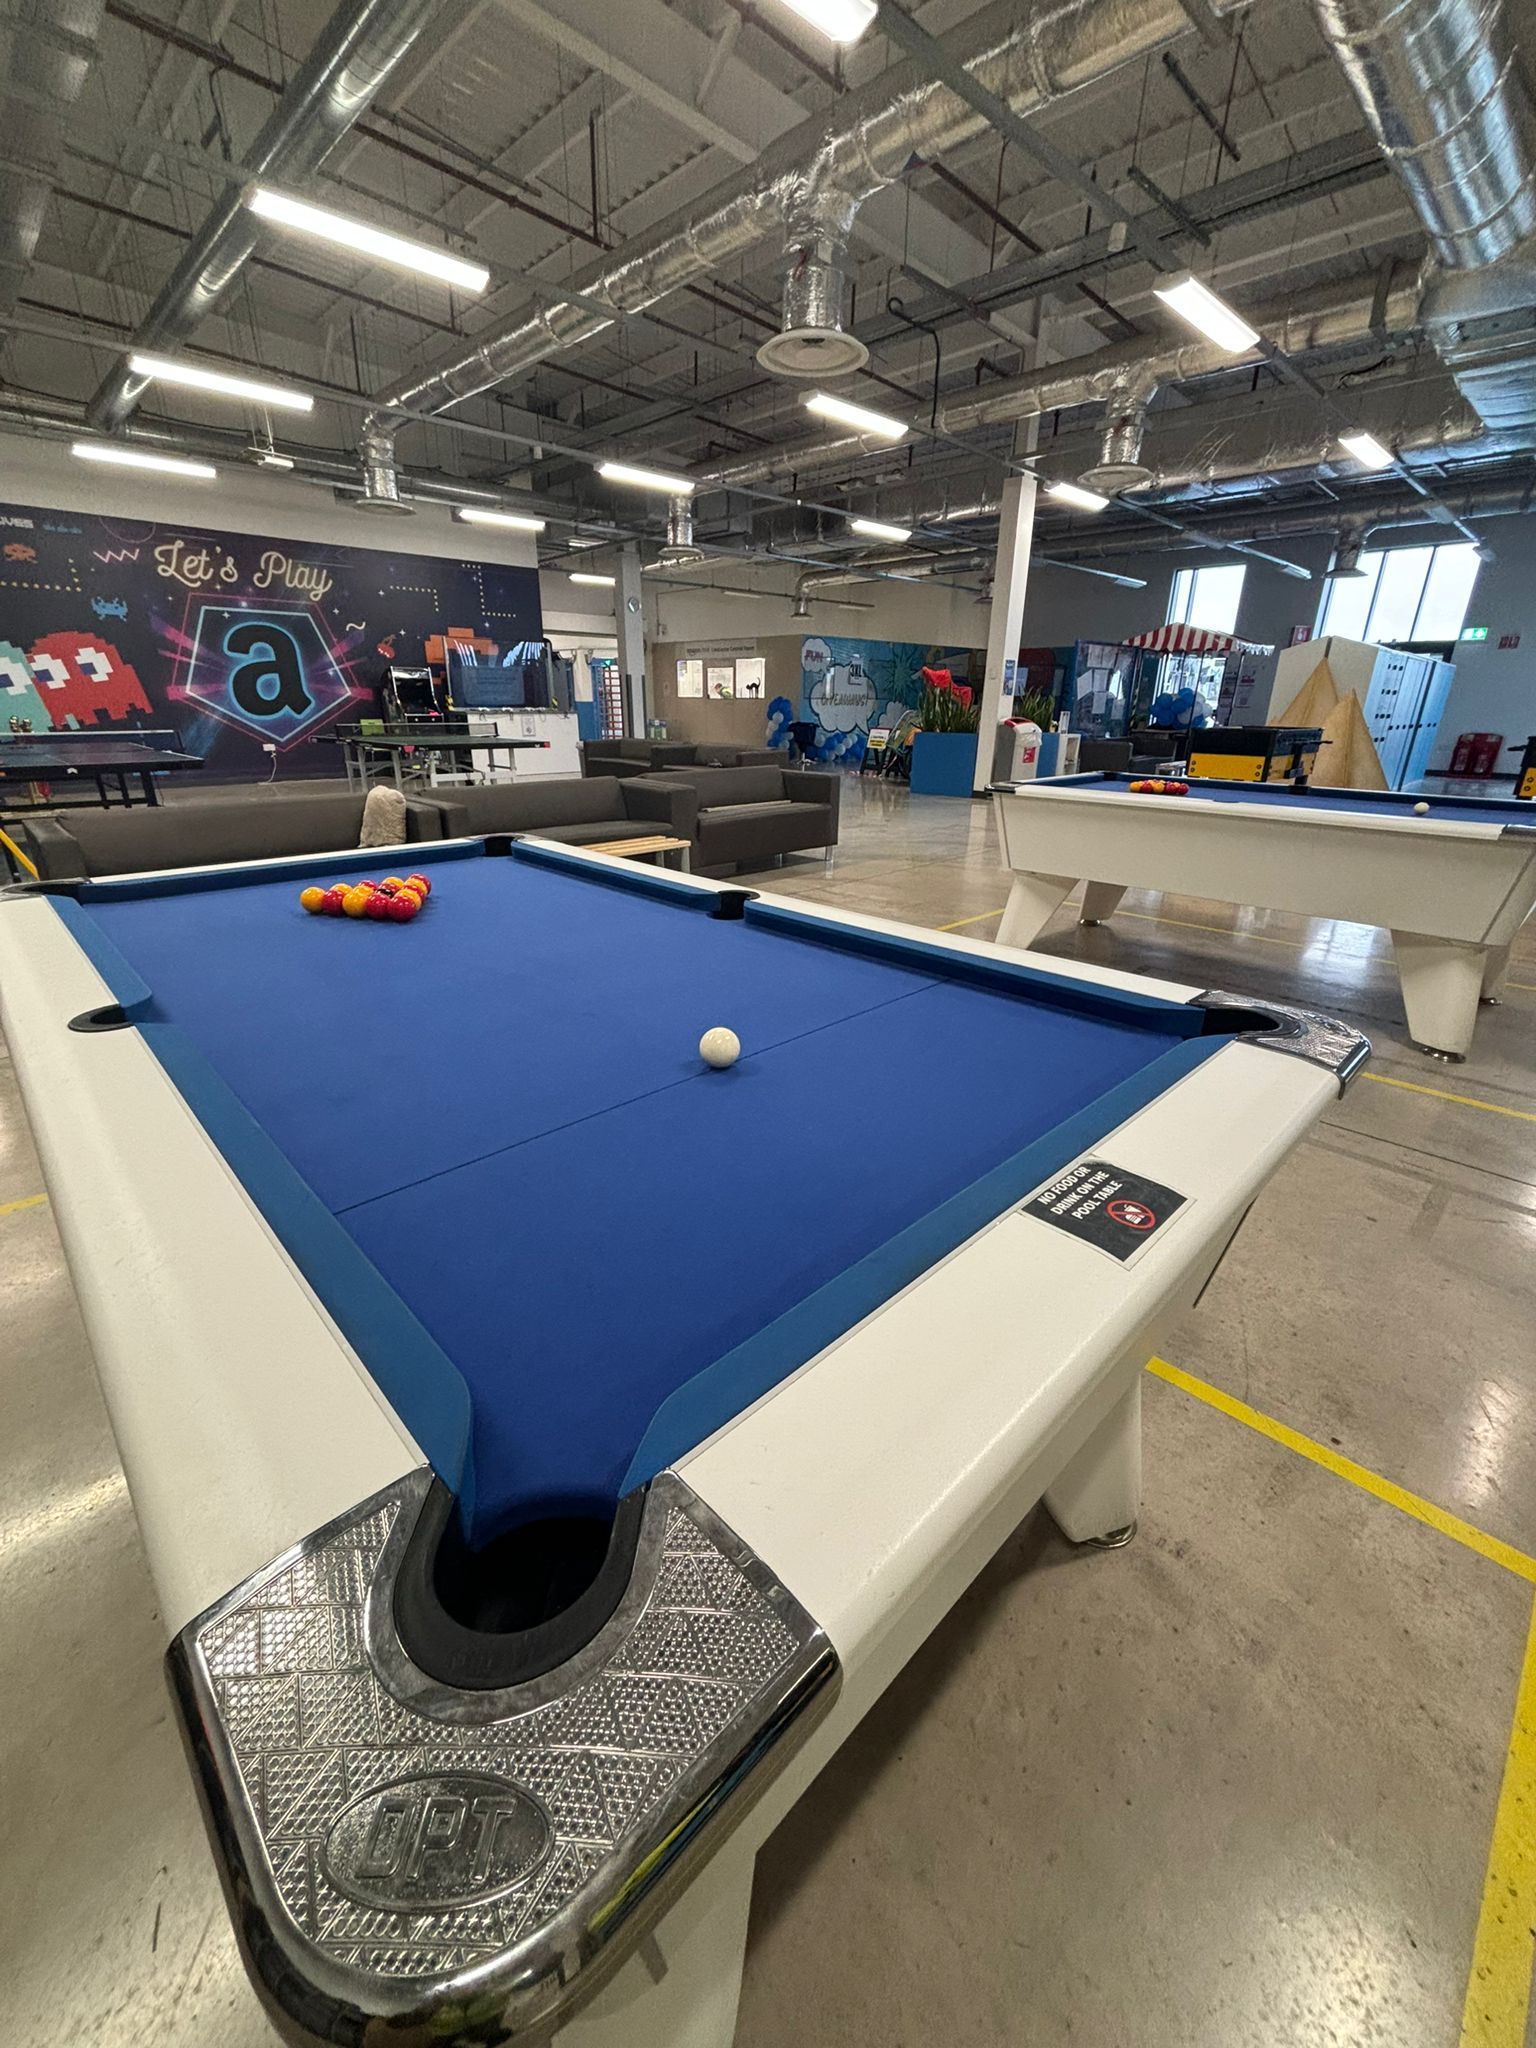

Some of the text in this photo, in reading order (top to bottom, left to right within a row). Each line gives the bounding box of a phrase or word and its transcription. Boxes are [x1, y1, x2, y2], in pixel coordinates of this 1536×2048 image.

[154, 540, 333, 602] Let's Play
[224, 622, 314, 719] a
[1037, 1166, 1091, 1205] NO FOOD OR
[1050, 1171, 1110, 1216] DRINK ON THE
[1072, 1180, 1123, 1220] POOL TABLE
